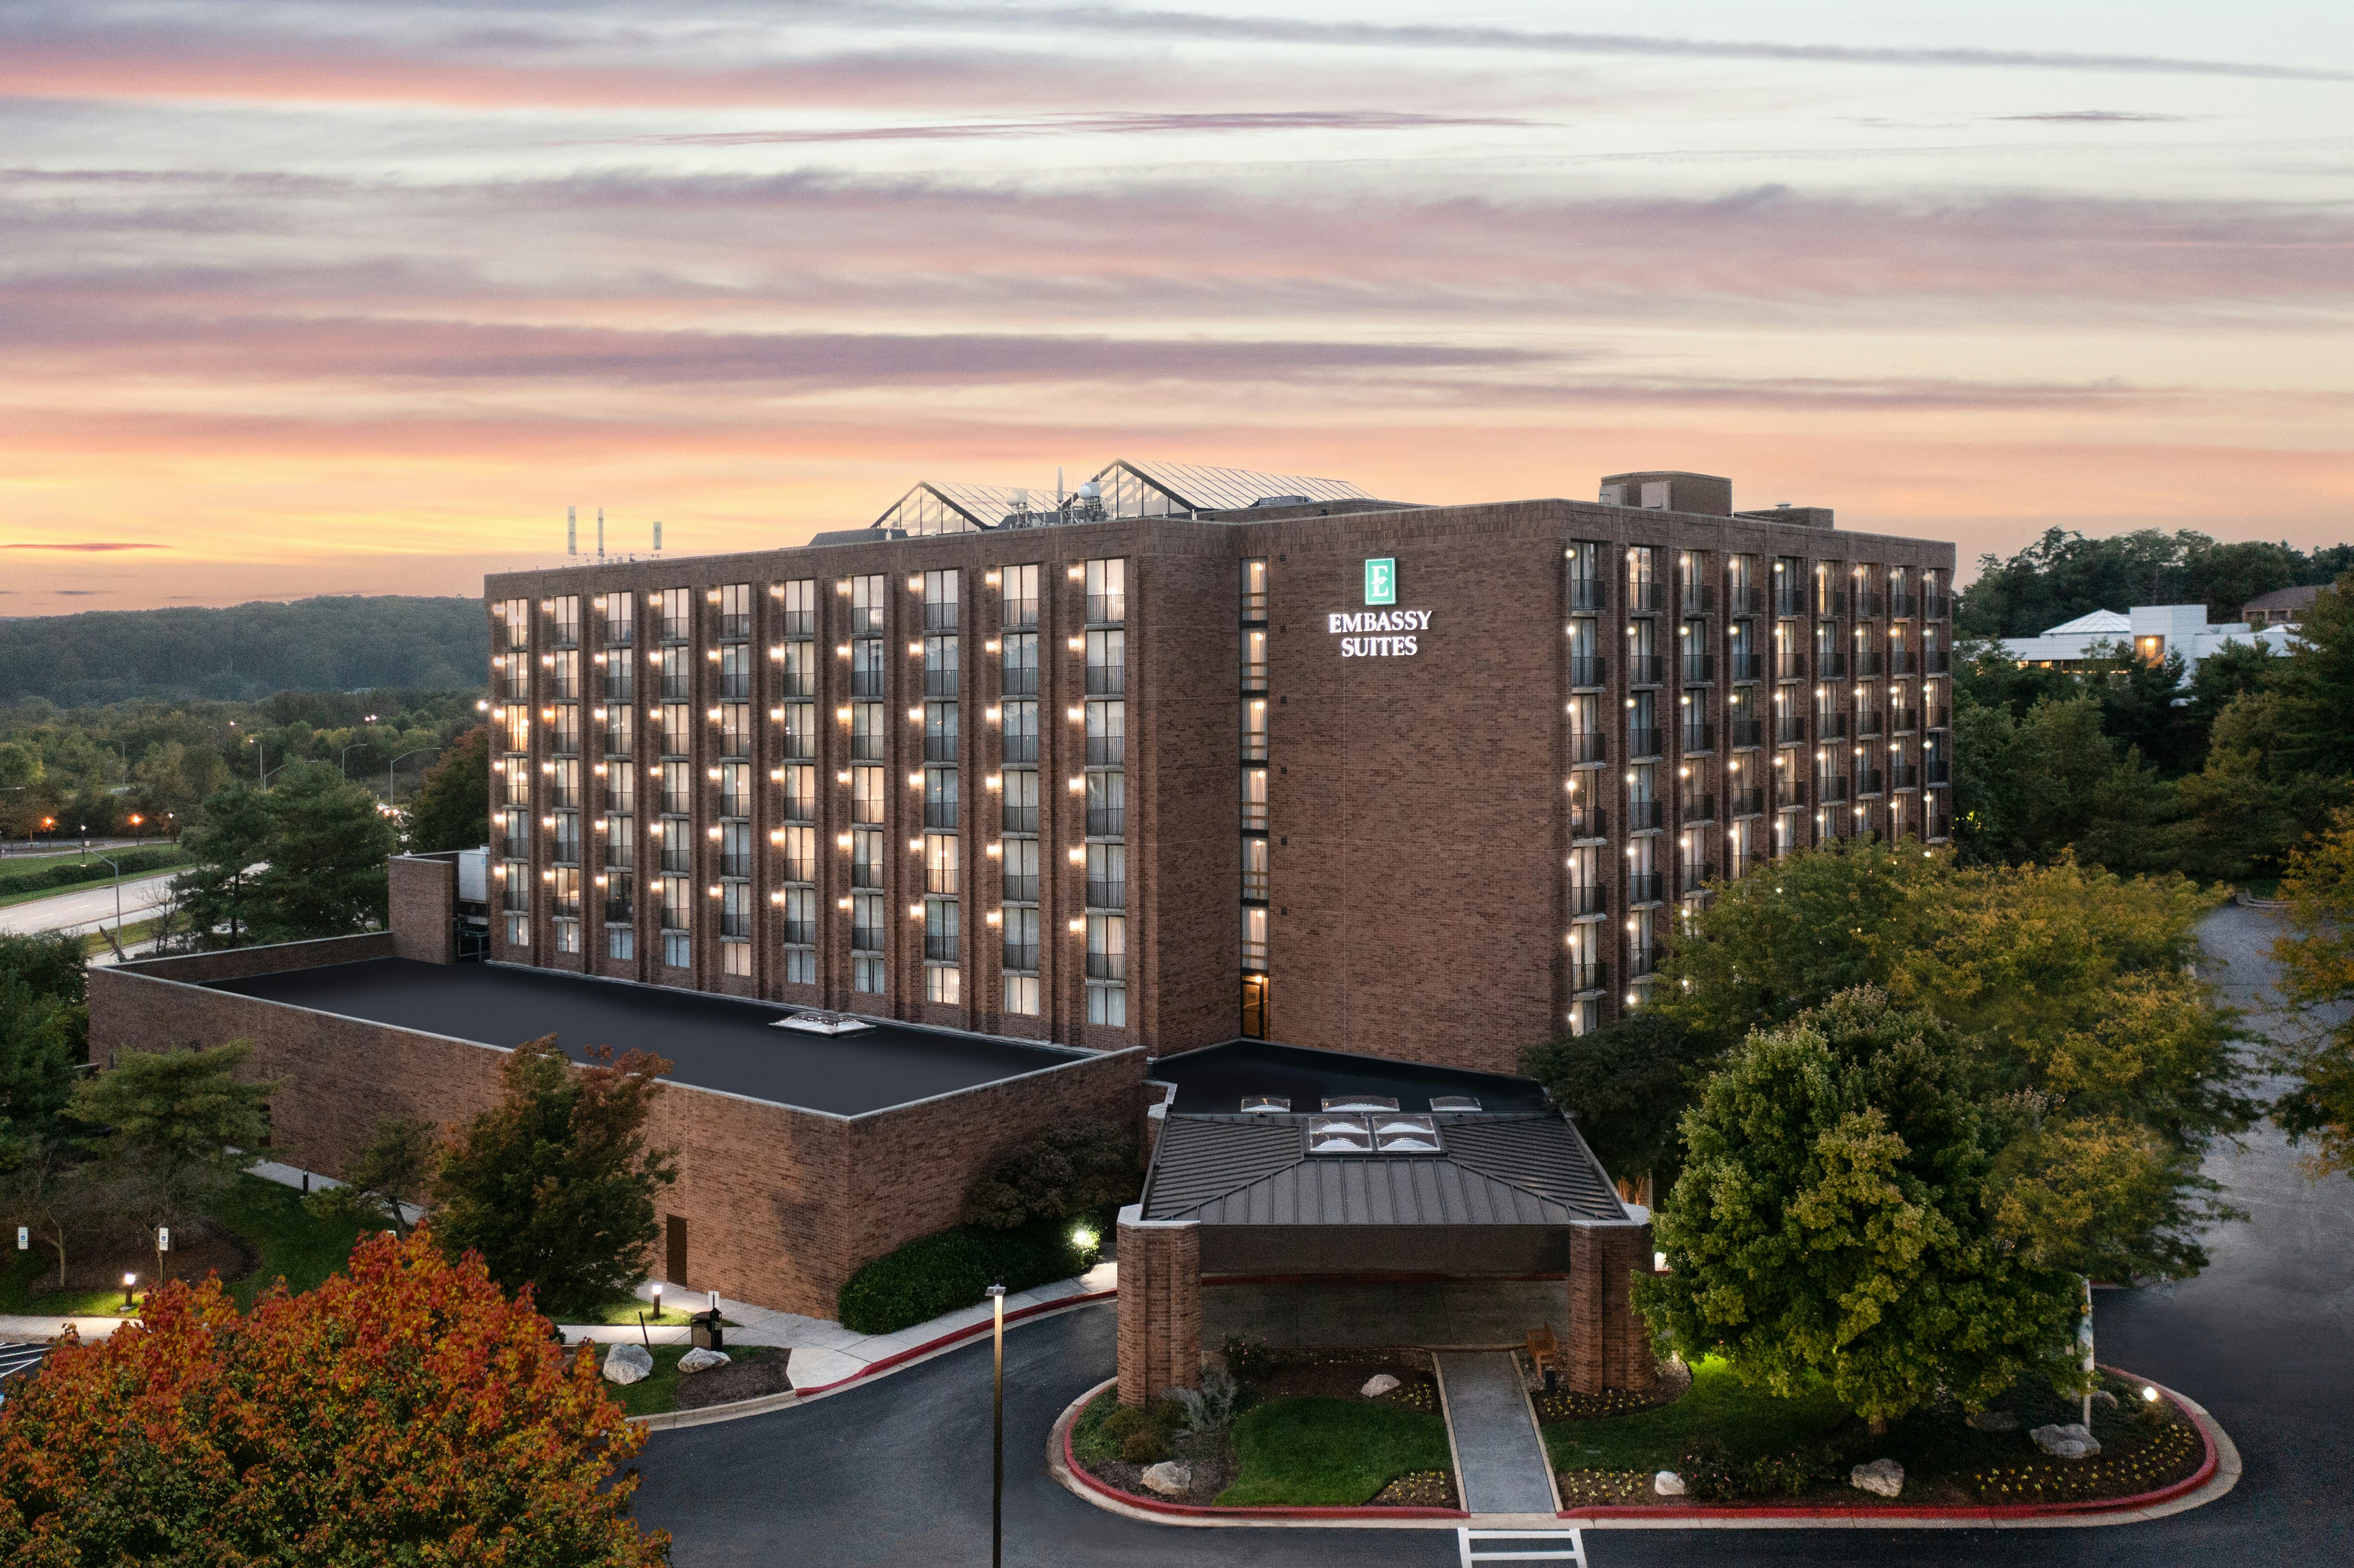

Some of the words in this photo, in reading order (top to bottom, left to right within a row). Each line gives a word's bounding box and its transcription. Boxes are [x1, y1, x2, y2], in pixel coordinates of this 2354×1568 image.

[1370, 565, 1389, 597] E
[1329, 610, 1432, 633] EMBASSY
[1341, 636, 1417, 657] SUITES
